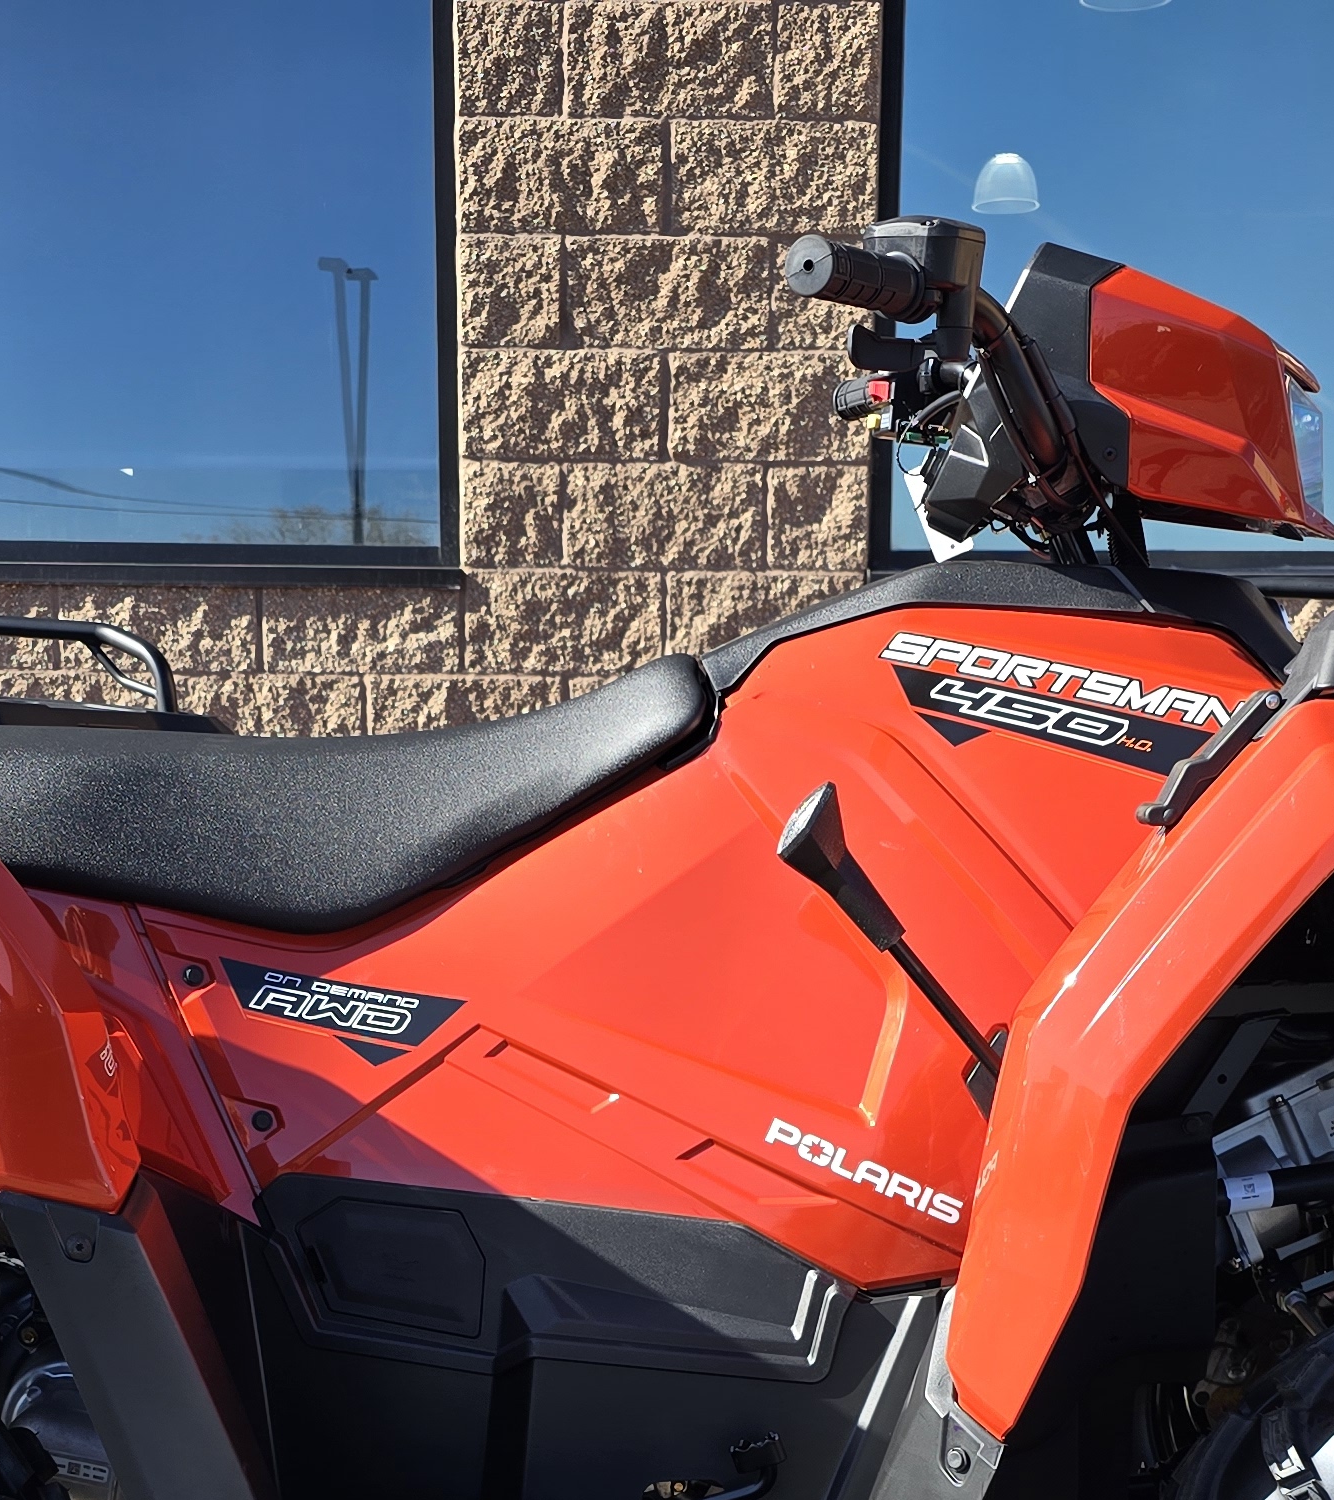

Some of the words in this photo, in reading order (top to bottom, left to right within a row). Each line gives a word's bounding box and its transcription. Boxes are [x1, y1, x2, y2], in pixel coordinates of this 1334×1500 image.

[879, 632, 1247, 728] SPORTSMAN
[929, 678, 1130, 747] 450
[1118, 734, 1152, 753] H.O.
[248, 984, 413, 1035] AWD
[264, 971, 302, 987] ON
[310, 980, 420, 1010] DEMAND
[764, 1116, 964, 1225] POLARIS
